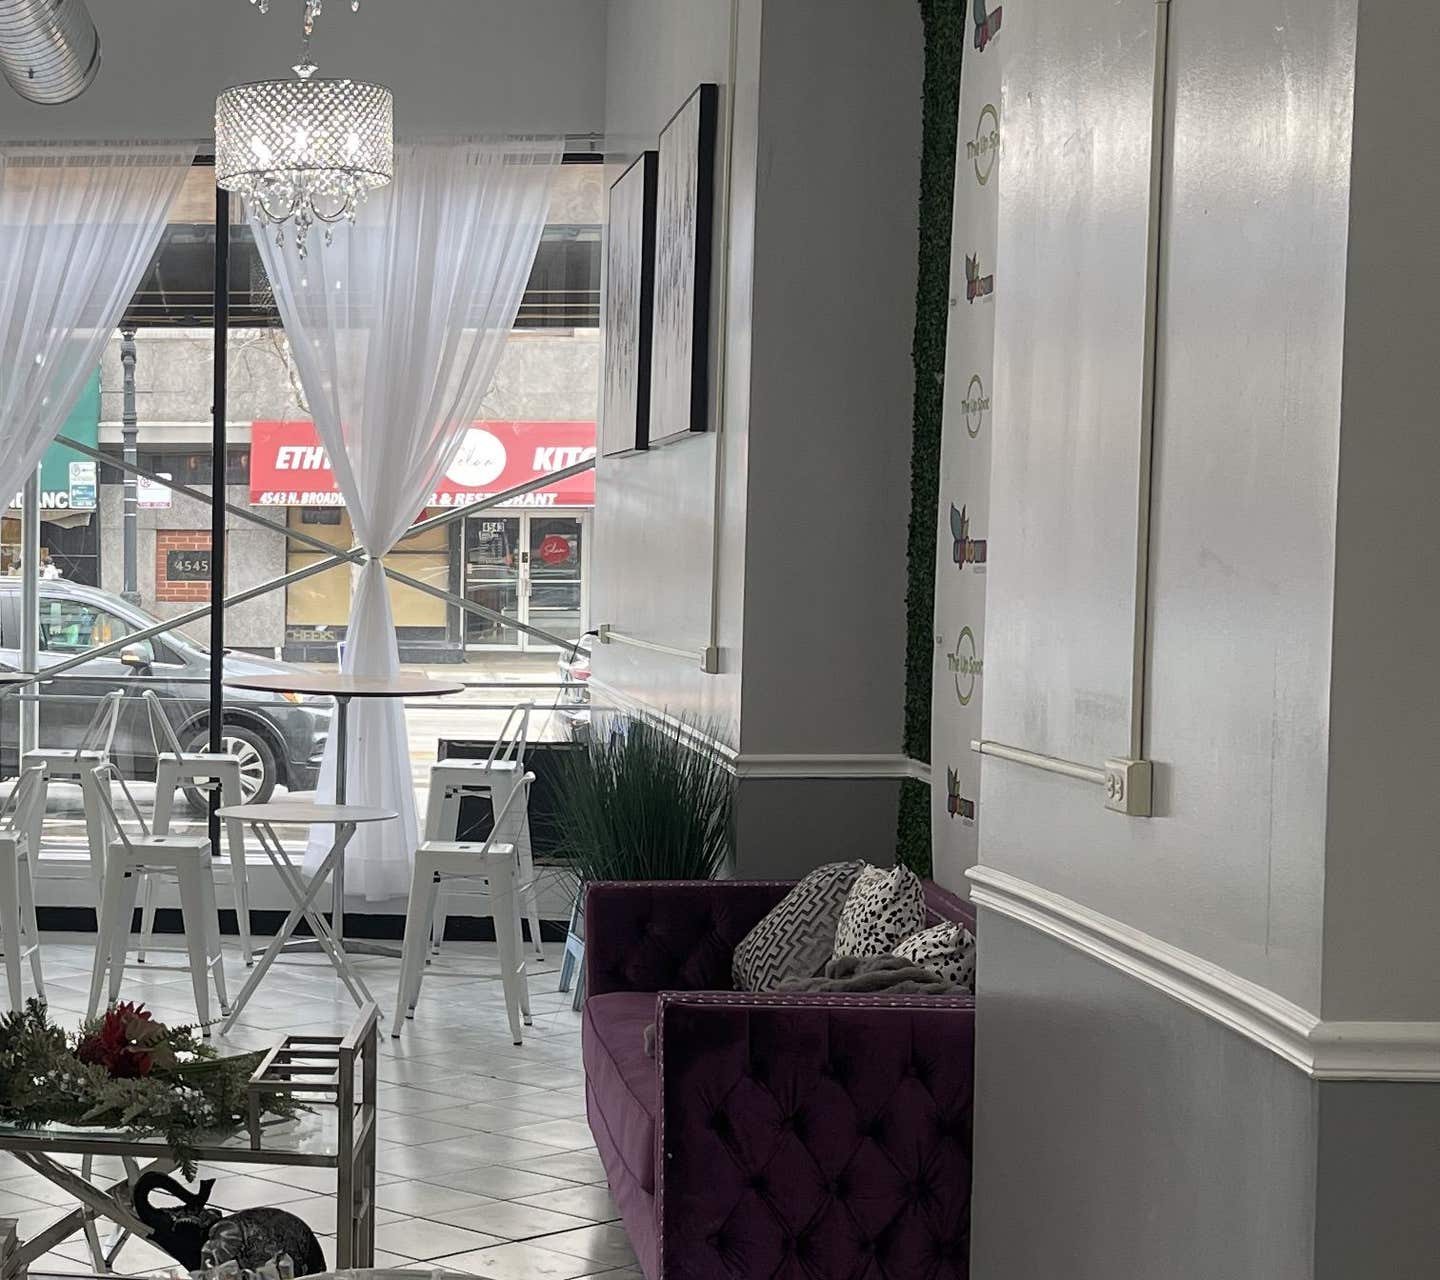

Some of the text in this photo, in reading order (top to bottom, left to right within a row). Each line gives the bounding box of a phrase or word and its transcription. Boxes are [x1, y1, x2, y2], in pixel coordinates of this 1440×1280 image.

[260, 491, 287, 504] 4543
[287, 492, 300, 504] N.
[176, 560, 209, 571] 4545
